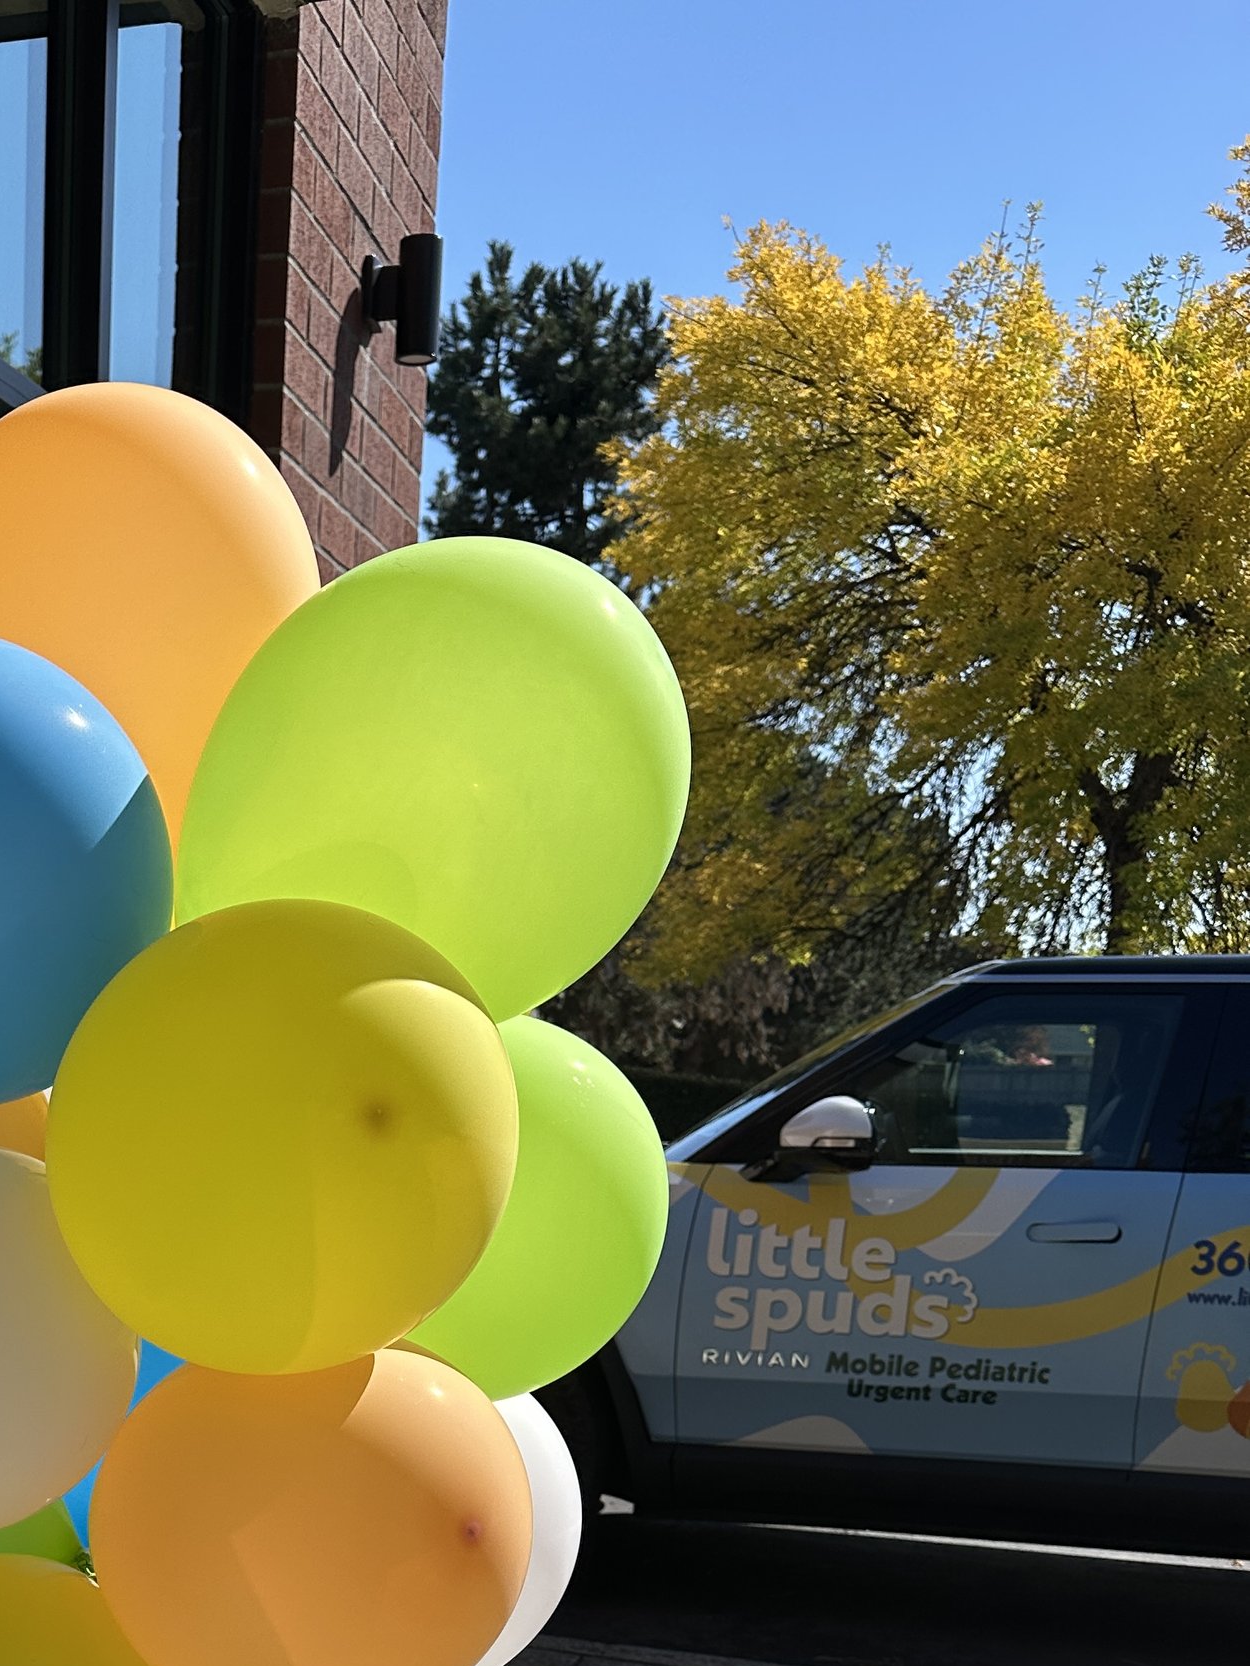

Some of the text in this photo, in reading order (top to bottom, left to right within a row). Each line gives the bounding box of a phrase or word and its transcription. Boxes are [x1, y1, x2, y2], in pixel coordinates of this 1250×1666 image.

[705, 1208, 897, 1282] little
[1191, 1239, 1250, 1277] 36
[712, 1274, 953, 1352] spuds
[701, 1349, 810, 1369] RIVIAN
[824, 1351, 1051, 1385] Mobile Pediatric
[846, 1378, 998, 1405] Urgent Care
